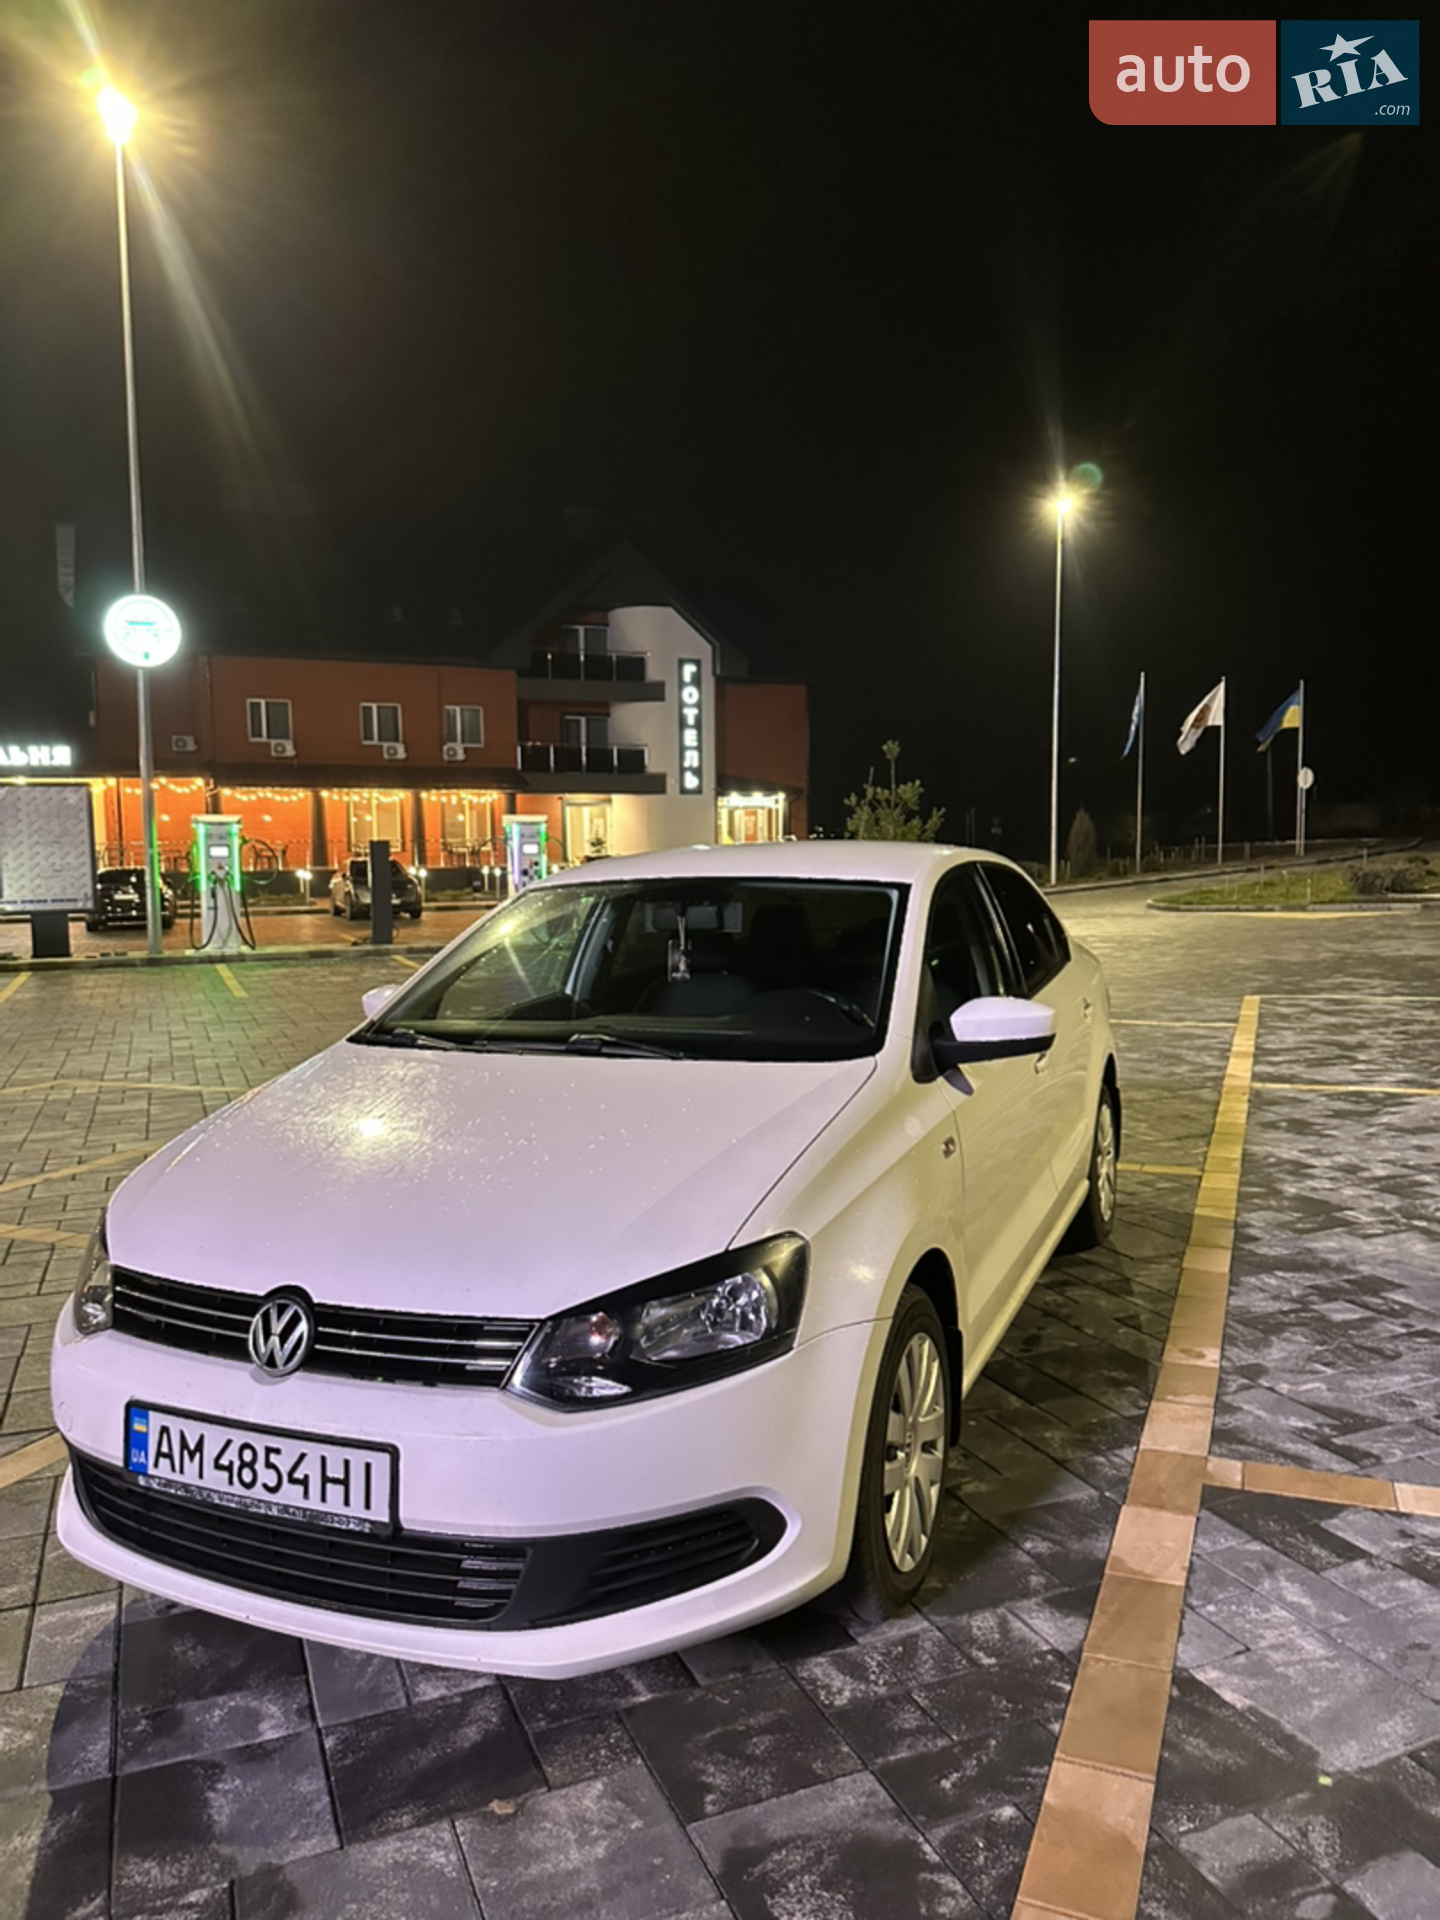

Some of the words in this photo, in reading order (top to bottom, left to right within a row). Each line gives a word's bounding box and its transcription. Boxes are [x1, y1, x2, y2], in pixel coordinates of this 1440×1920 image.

[682, 663, 700, 789] ГОТЕЛЬ
[131, 1448, 147, 1464] UA
[153, 1425, 205, 1480] AM
[213, 1438, 309, 1501] 4854
